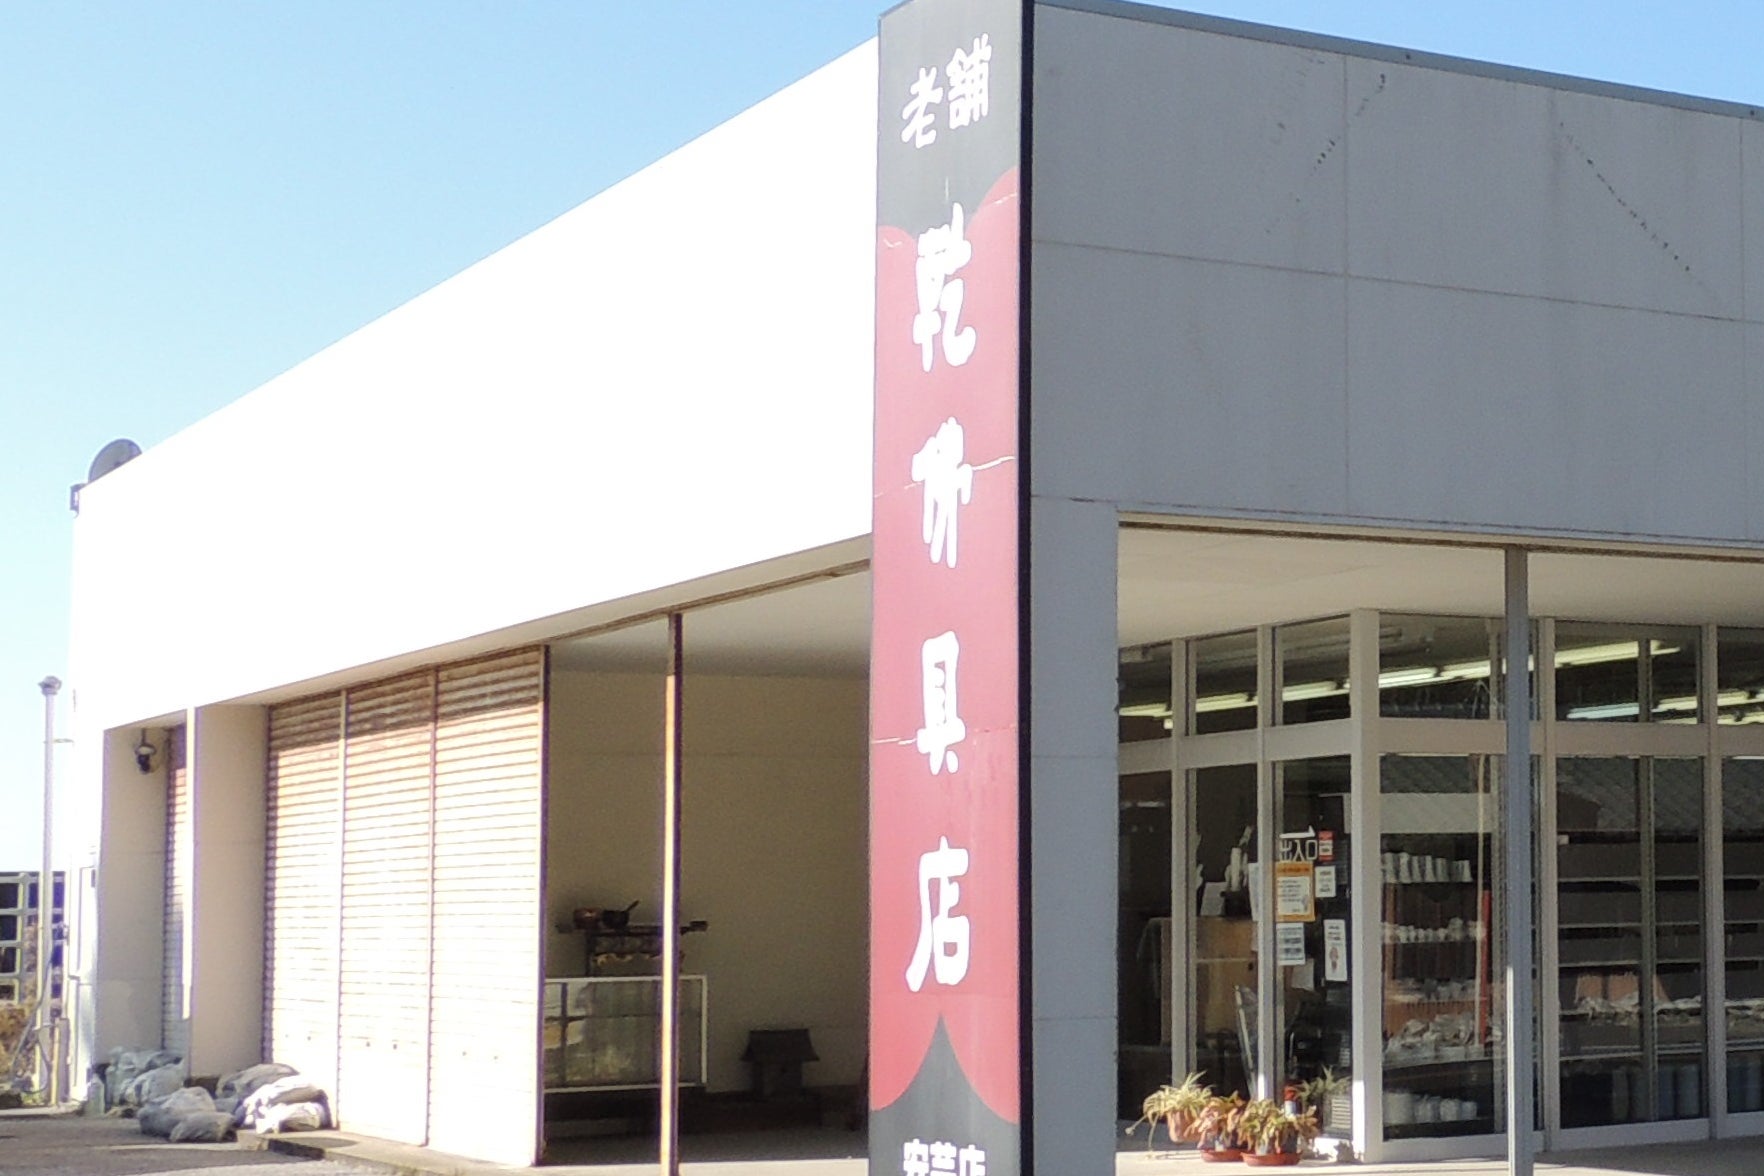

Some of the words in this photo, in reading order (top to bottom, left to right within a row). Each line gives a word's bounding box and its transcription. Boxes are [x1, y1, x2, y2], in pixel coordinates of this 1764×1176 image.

[901, 33, 992, 149] 老舗
[1279, 839, 1318, 862] 出入口
